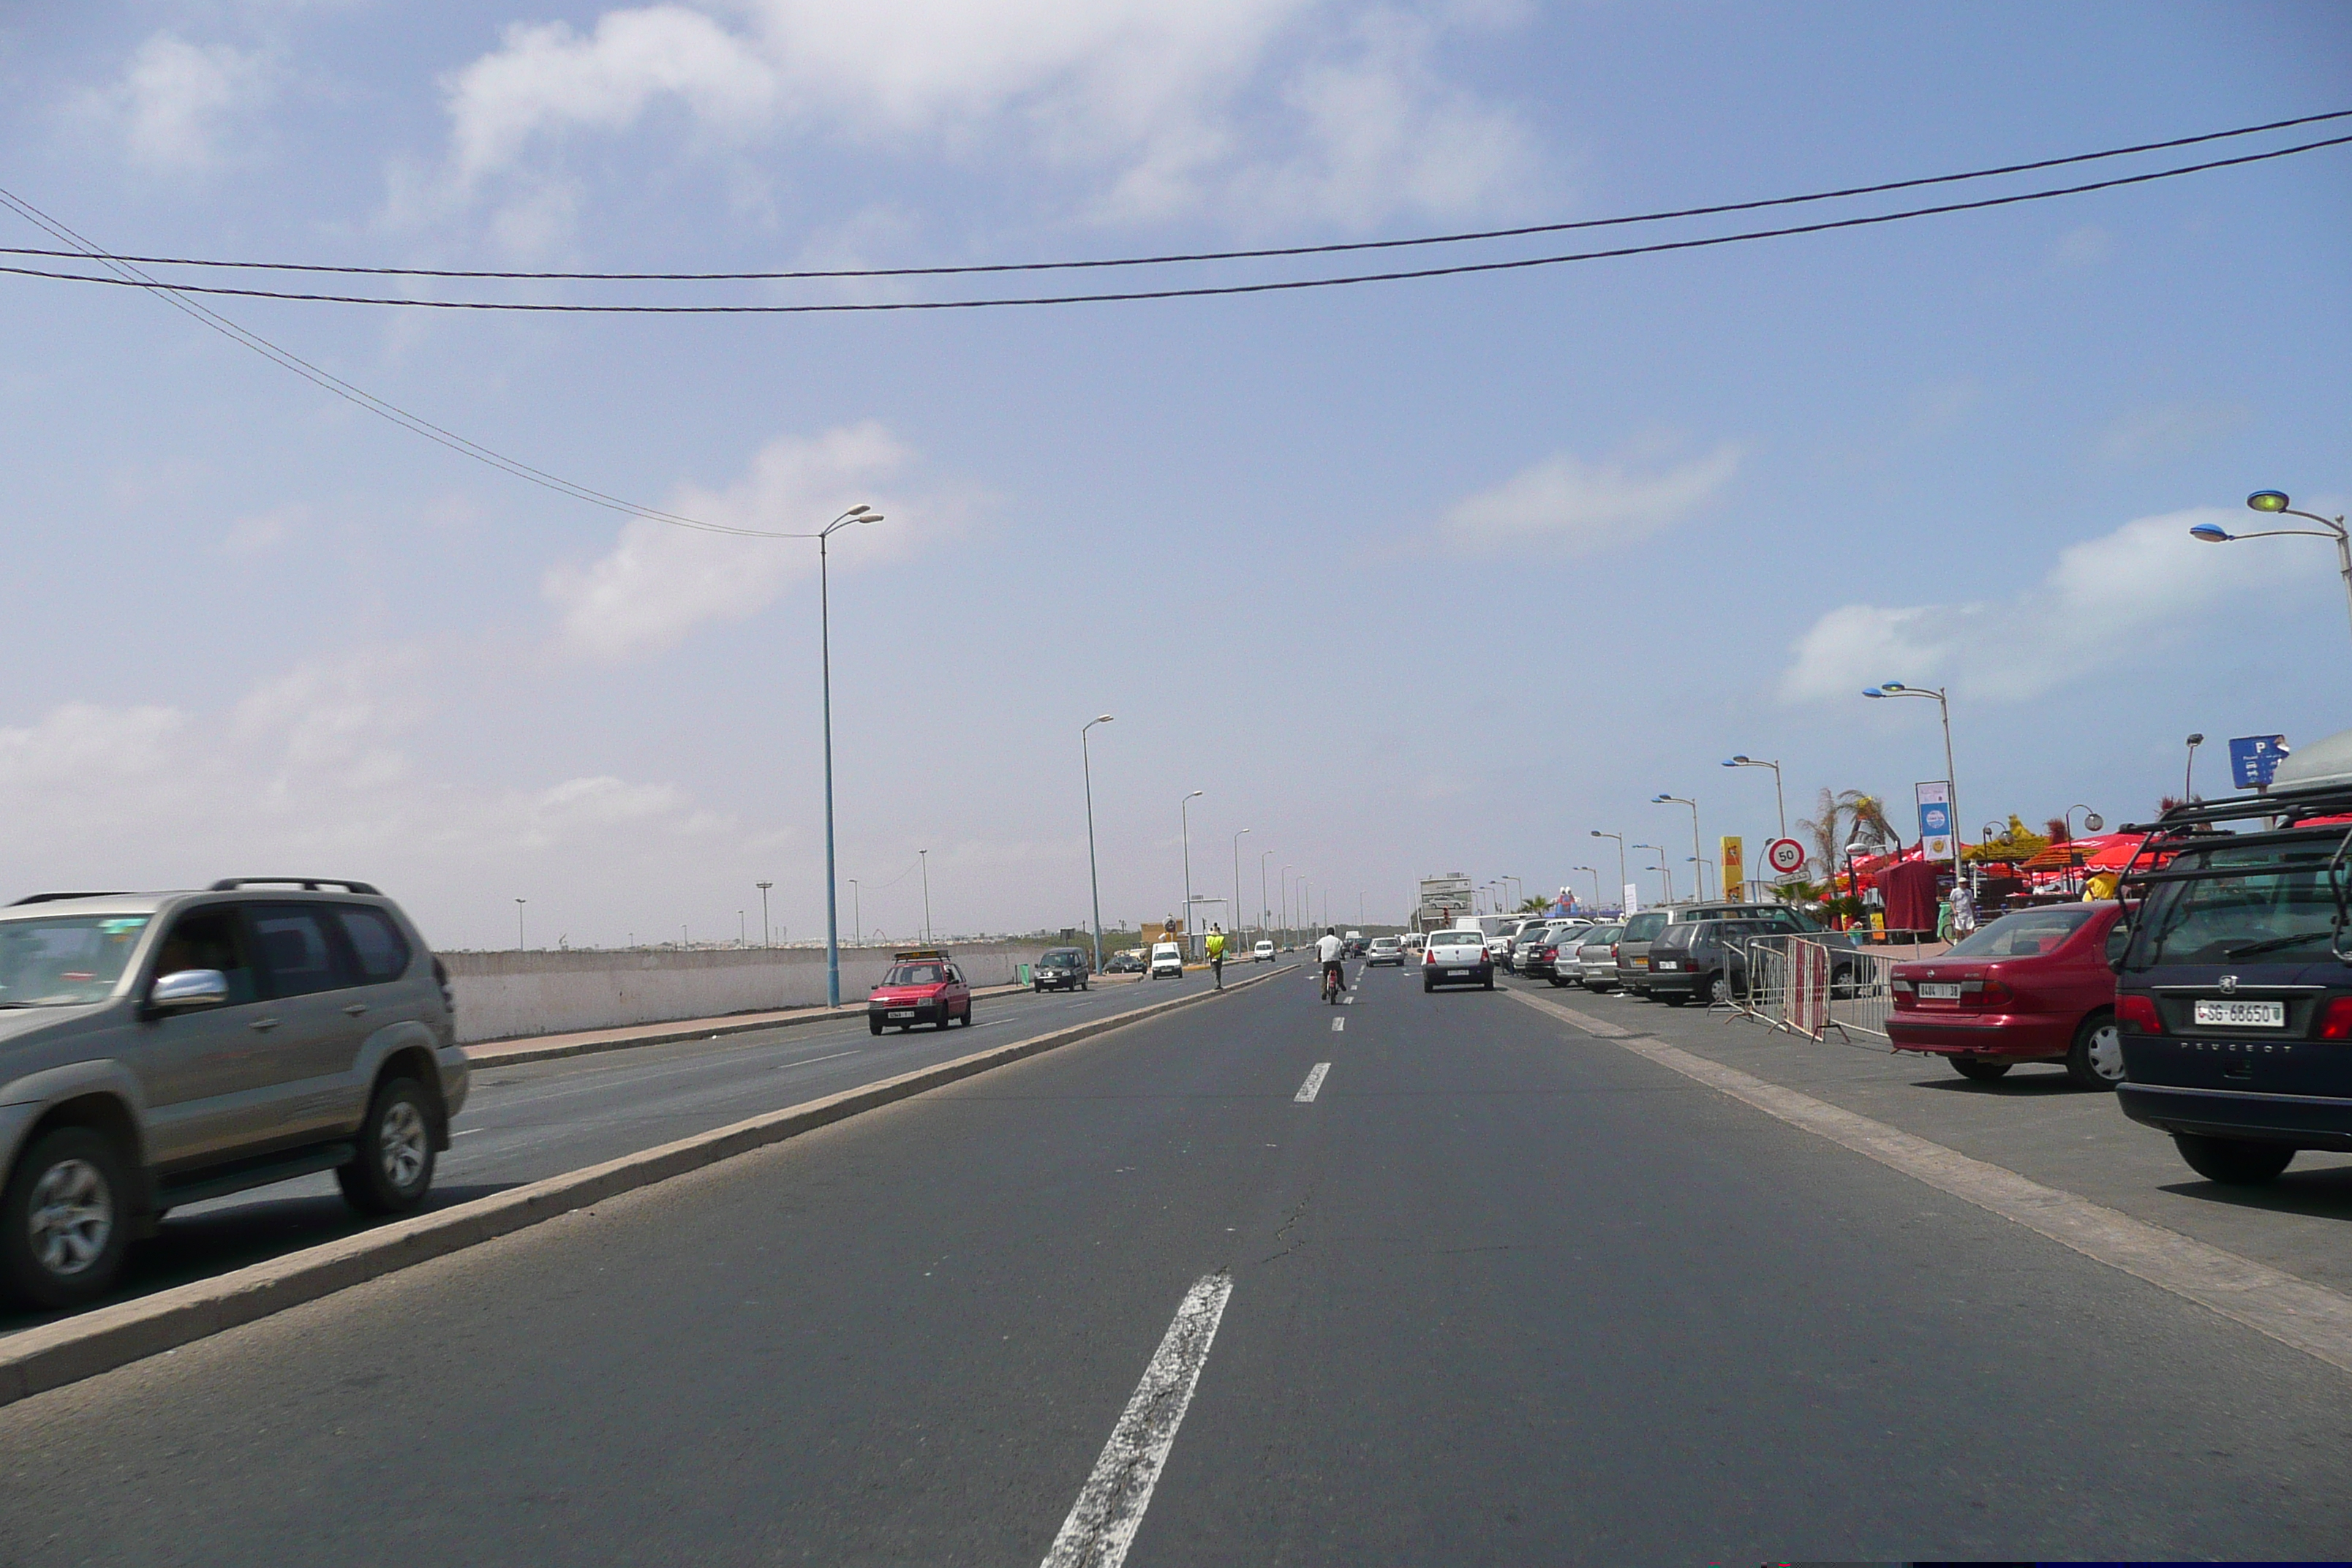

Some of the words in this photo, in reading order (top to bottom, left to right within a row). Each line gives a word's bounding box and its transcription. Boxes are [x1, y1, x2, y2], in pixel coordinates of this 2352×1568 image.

[2255, 742, 2266, 753] P
[1779, 850, 1794, 862] 50
[2181, 1042, 2292, 1053] PEUGEOT
